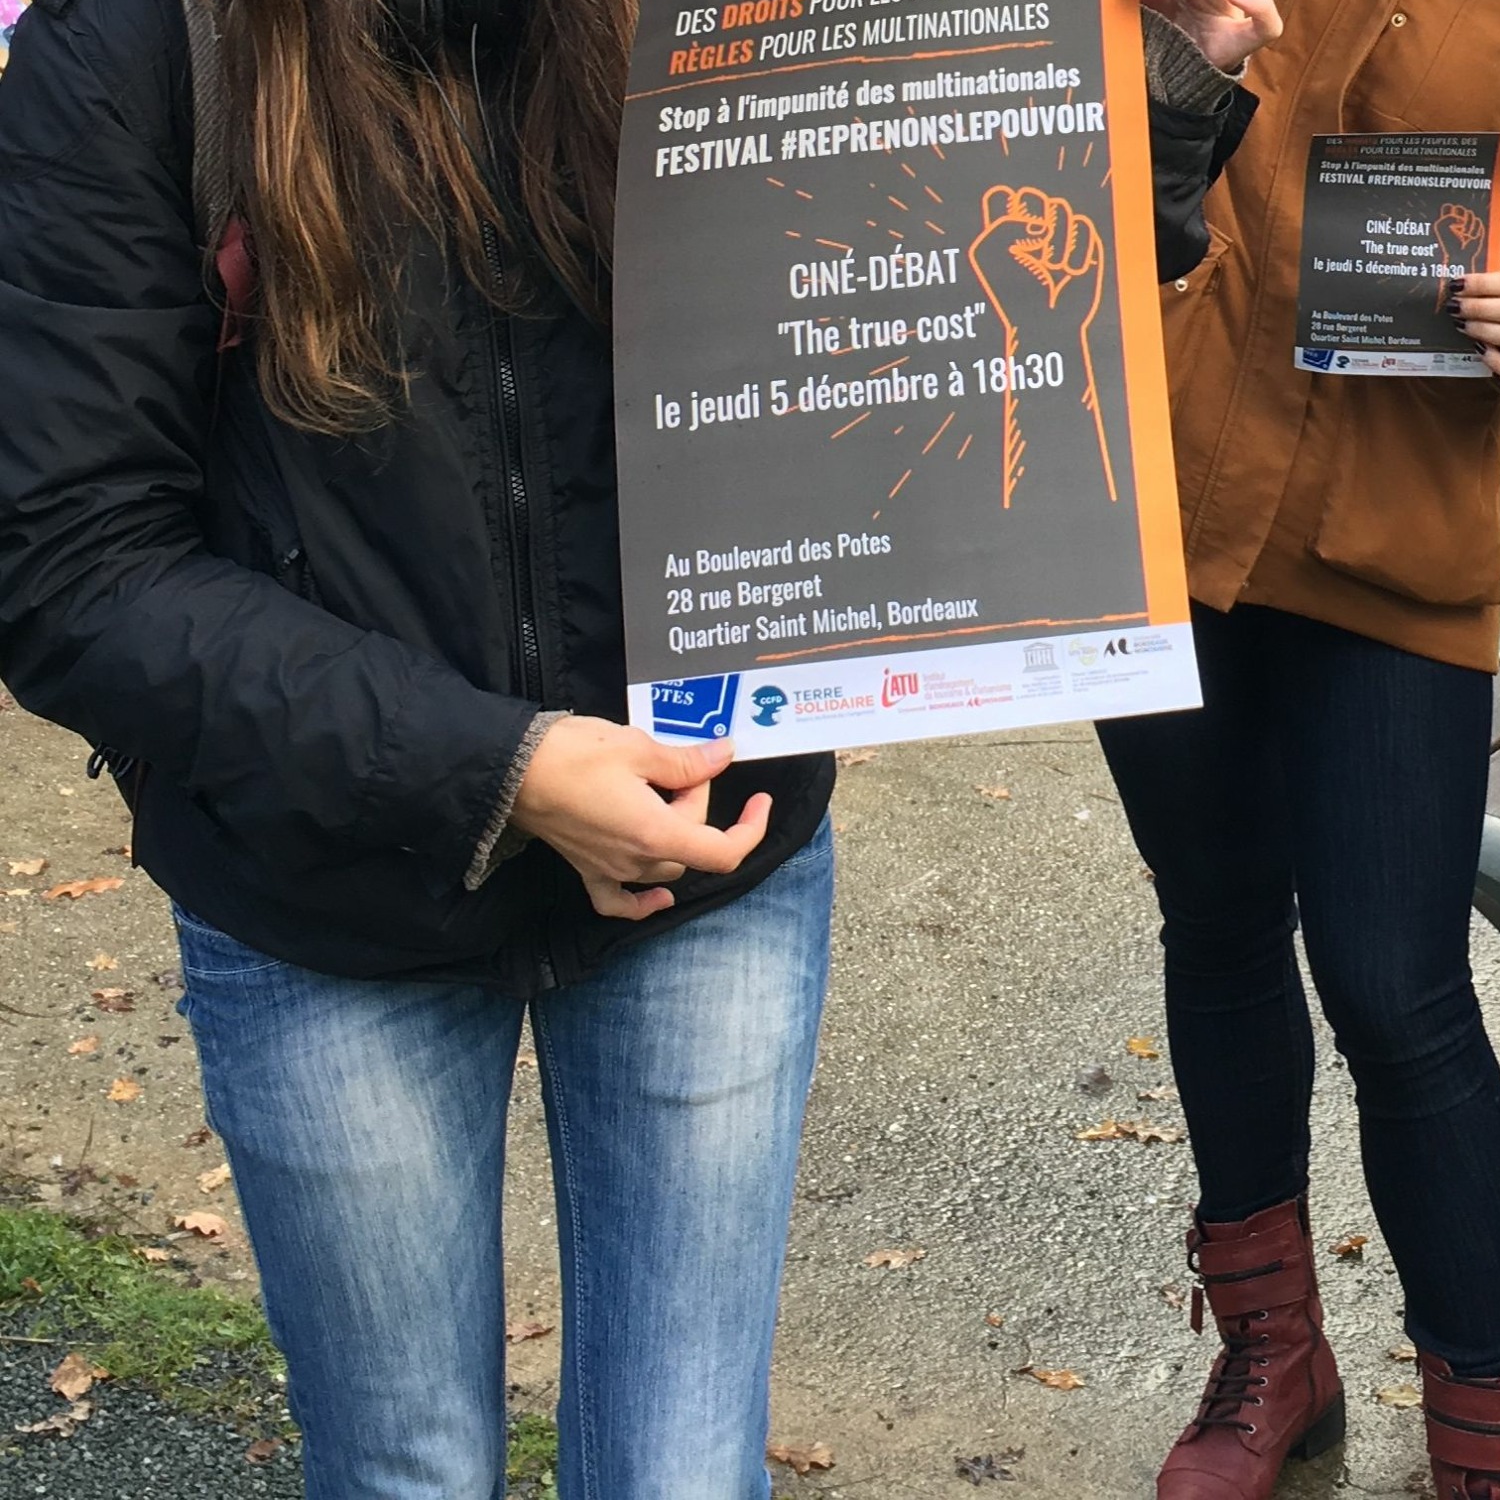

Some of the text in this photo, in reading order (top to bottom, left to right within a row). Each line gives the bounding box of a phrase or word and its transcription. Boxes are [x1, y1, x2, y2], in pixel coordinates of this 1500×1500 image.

[669, 2, 1050, 75] RÈGLES POUR LES MULTINATIONALES
[675, 7, 718, 37] DES
[658, 62, 1081, 133] Stop à l'impunité des multinationales
[656, 101, 1105, 178] FESTIVAL #REPRENONSLEPOUVOIR
[1319, 172, 1492, 190] FESTIVAL #REPRENONSLEPOUVOIR
[1366, 216, 1432, 236] CINÉ-DÉBAT
[790, 239, 960, 300] CINÉ-DÉBAT
[1313, 256, 1464, 277] le jeudi 5 décembre à 18h30
[1360, 239, 1439, 257] "The true cost"
[778, 302, 986, 356] "The true cost"
[655, 351, 1064, 432] le jeudi 5 décembre à 18h30
[664, 532, 892, 579] Au Boulevard des Potes
[666, 575, 822, 615] 28 rue Bergeret
[668, 597, 979, 655] Quartier Saint Michel, Bordeaux
[794, 687, 842, 701] TERRE
[795, 695, 874, 714] SOLIDAIRE
